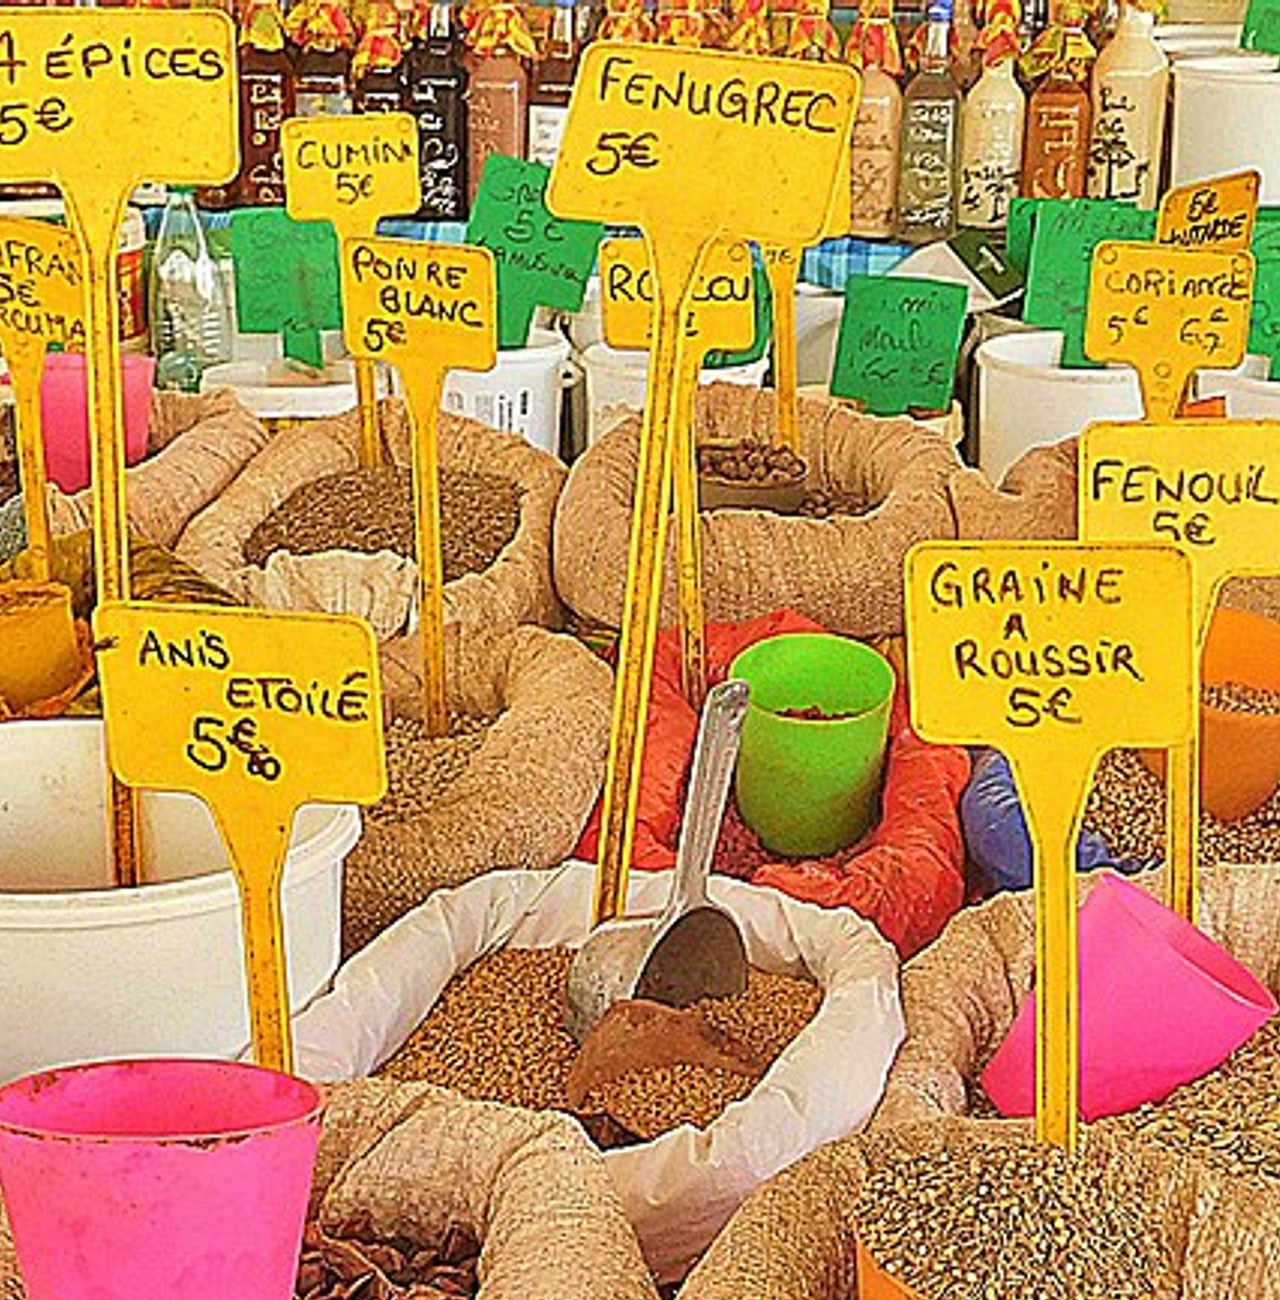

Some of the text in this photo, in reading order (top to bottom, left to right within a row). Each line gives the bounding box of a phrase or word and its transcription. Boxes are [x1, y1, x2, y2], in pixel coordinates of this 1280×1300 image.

[598, 56, 843, 135] FENUGREC
[585, 131, 660, 176] 5€
[335, 172, 375, 206] 5€
[379, 284, 484, 328] BLANC
[362, 317, 408, 352] 5€
[1152, 511, 1217, 546] 5€
[1003, 612, 1029, 642] A
[138, 629, 231, 671] ANIS
[1004, 686, 1084, 728] 5€
